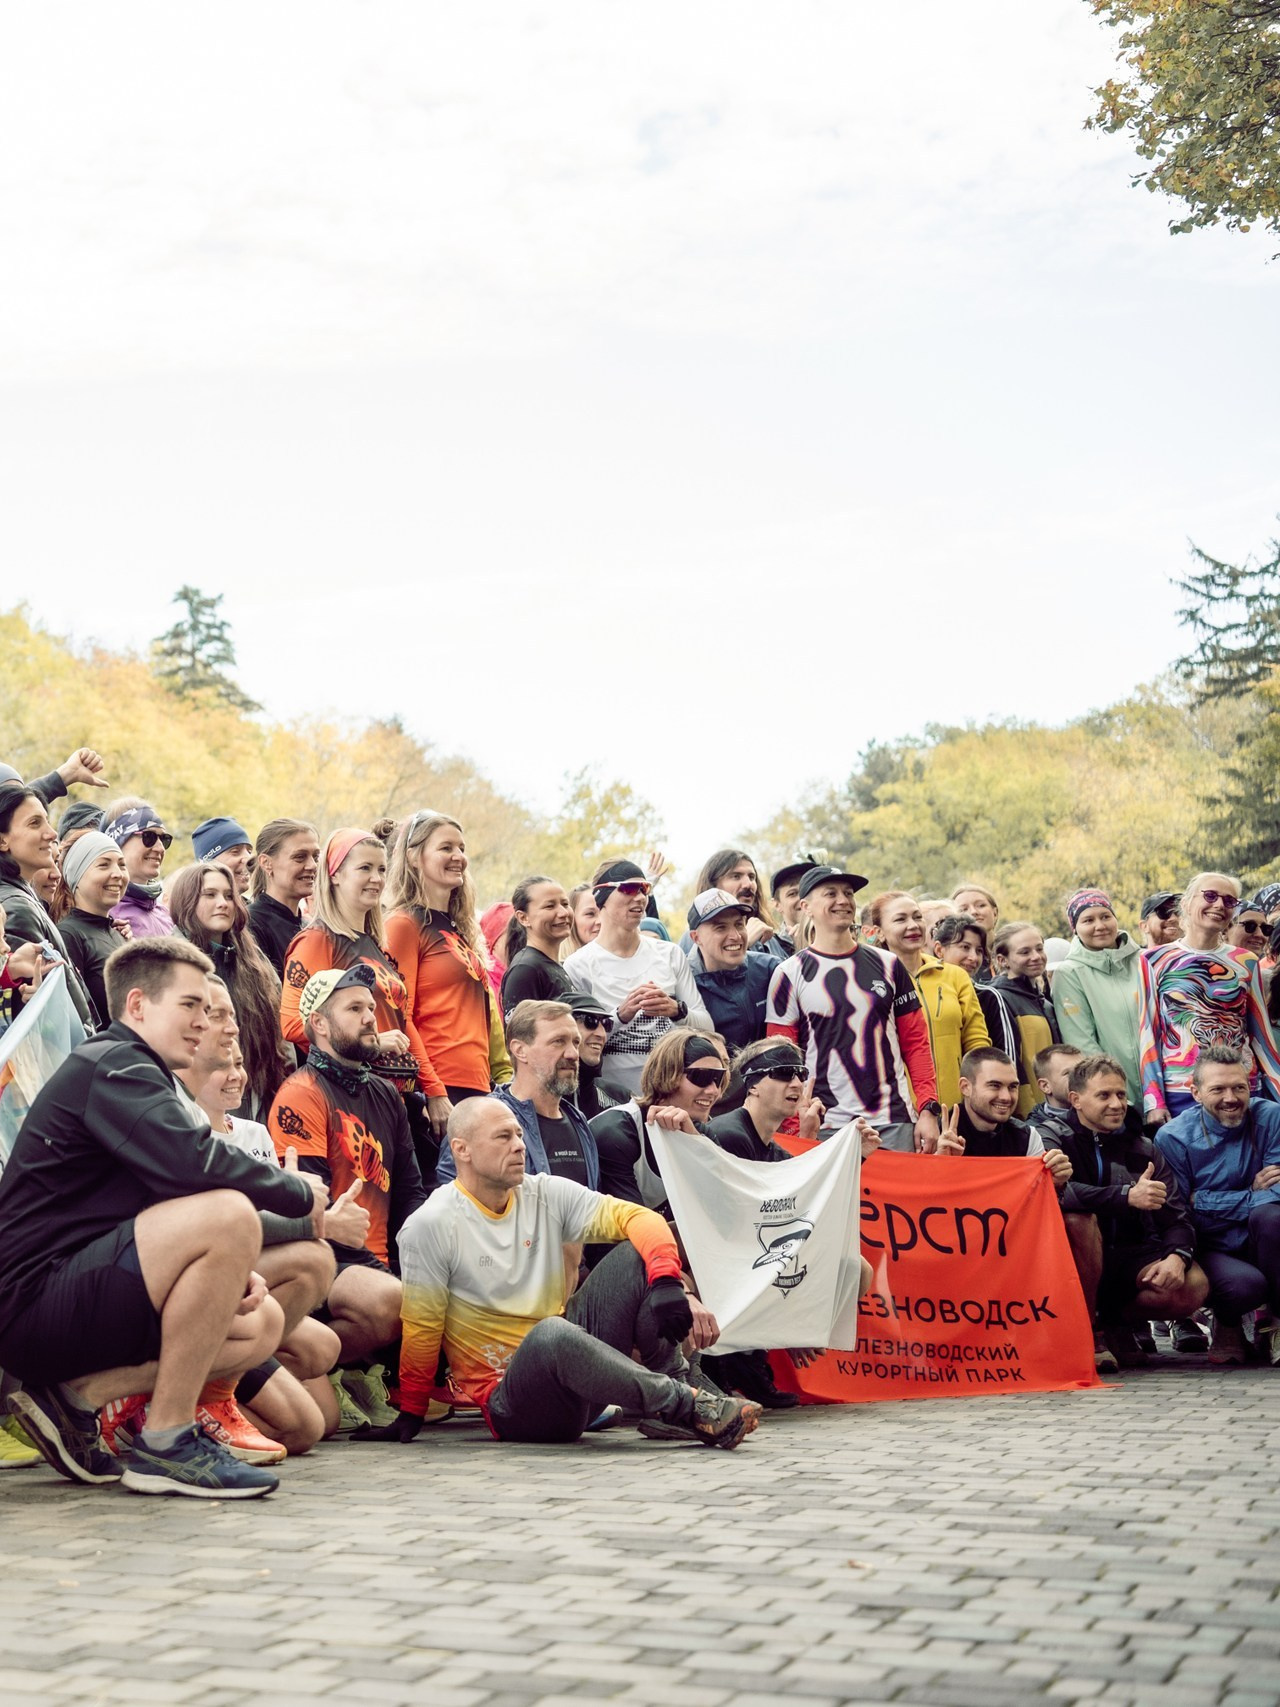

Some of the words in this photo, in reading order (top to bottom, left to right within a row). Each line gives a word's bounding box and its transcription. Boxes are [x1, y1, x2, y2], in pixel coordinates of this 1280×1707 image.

[894, 994, 908, 1006] TOV
[860, 1188, 1009, 1261] ёрст
[857, 1293, 1058, 1330] ЕЗНОВОДСК
[855, 1338, 1020, 1363] ЛЕЗНОВОДСКИЙ
[837, 1360, 959, 1383] КУРОРТНЫЙ
[966, 1367, 1026, 1383] ПАРК
